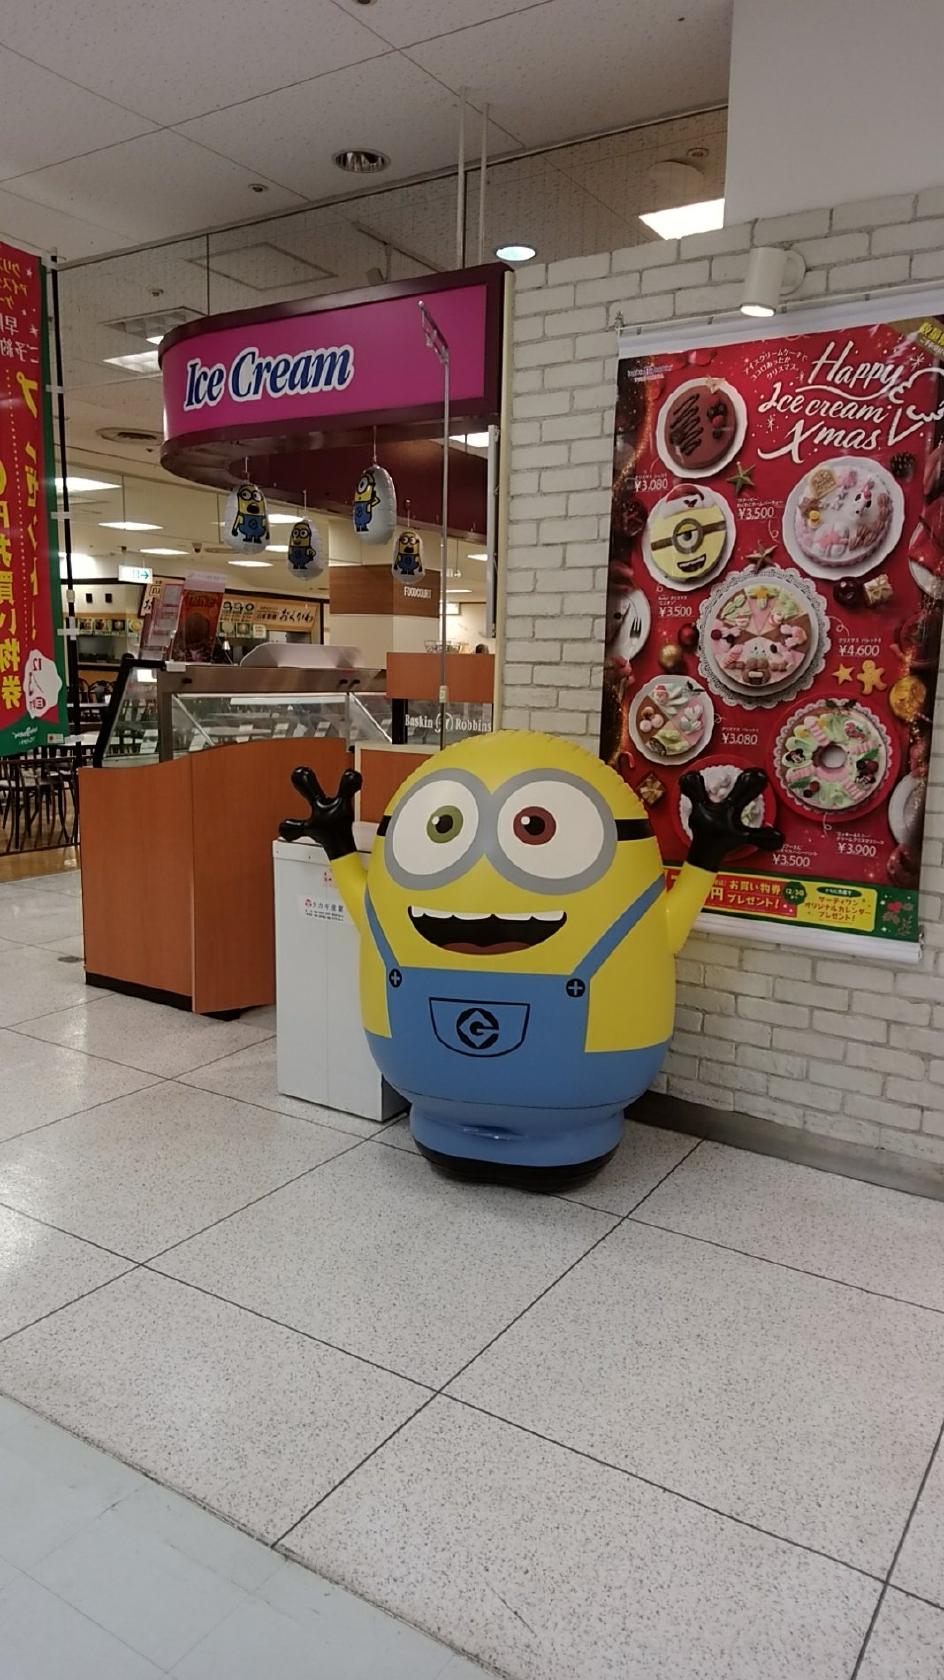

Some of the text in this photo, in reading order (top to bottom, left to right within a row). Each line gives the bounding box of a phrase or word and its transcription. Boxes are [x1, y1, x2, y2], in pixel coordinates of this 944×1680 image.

[184, 347, 354, 411] Ice Cream
[803, 341, 905, 398] Happy
[757, 381, 889, 424] Ice cream
[757, 419, 882, 464] Xmas
[405, 714, 433, 729] Baskin
[455, 718, 491, 733] Robbins
